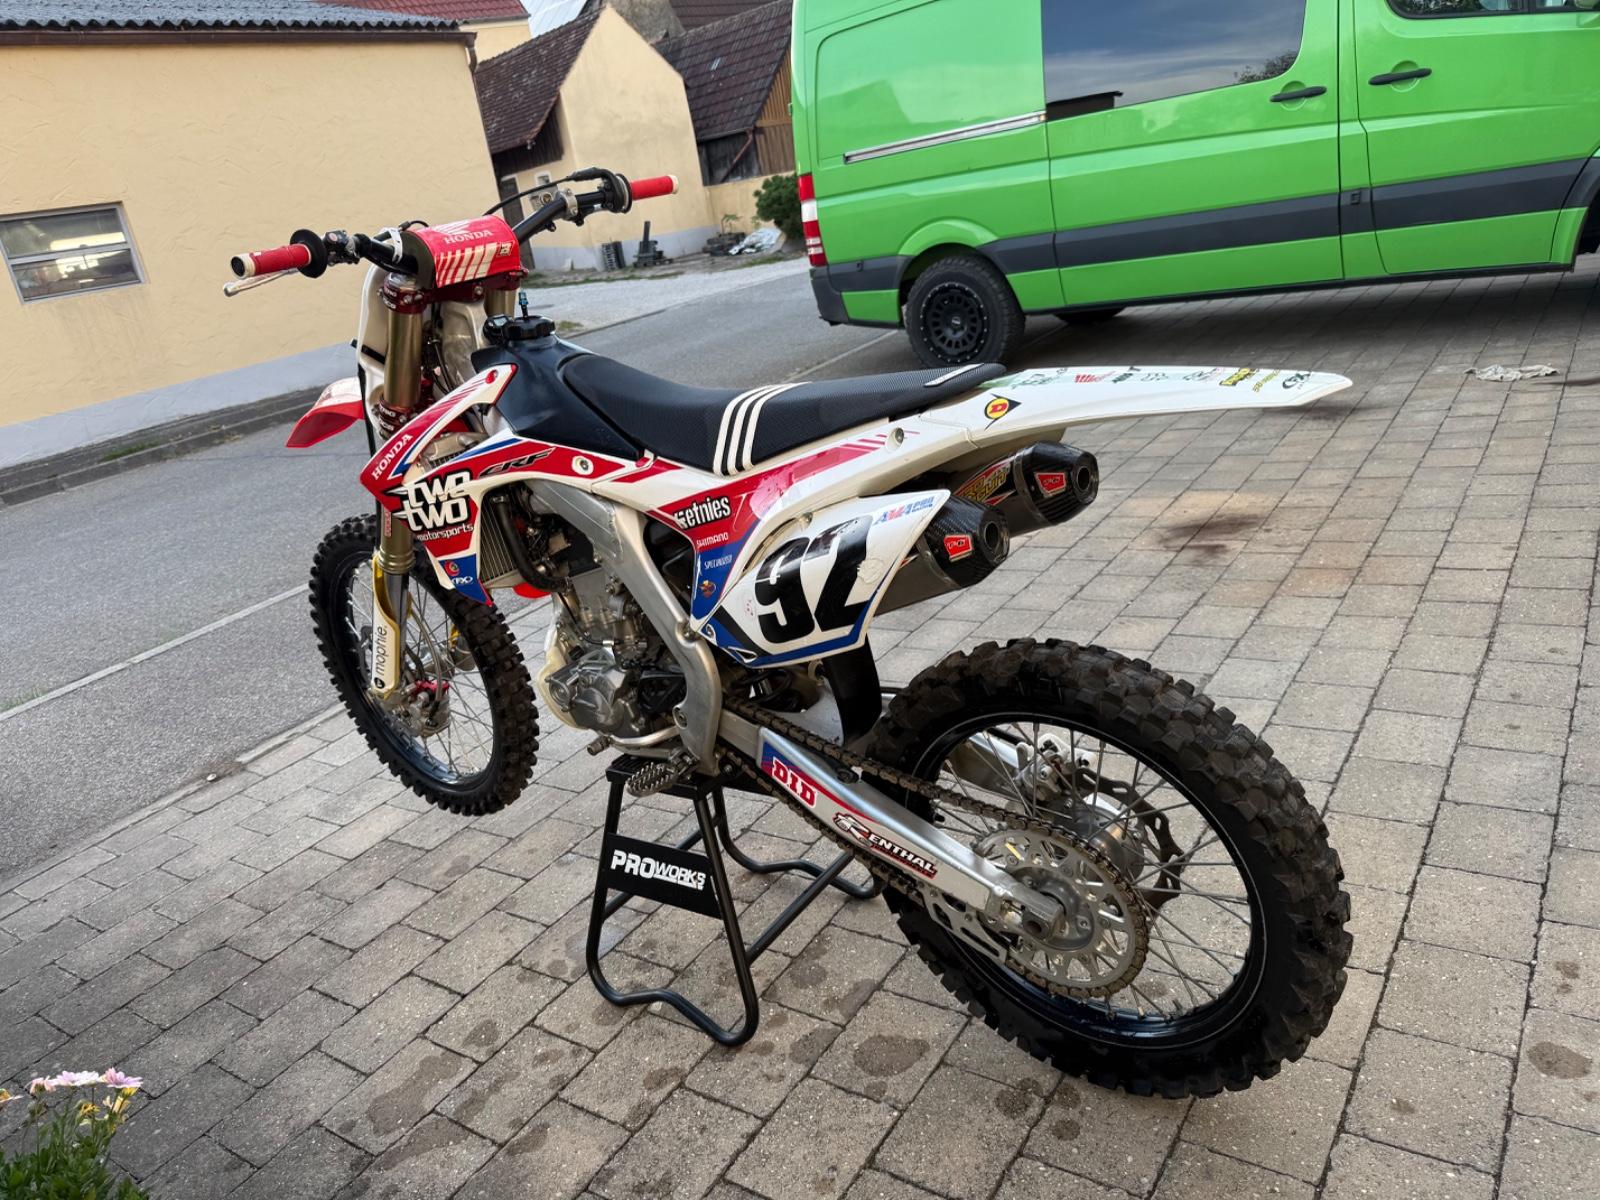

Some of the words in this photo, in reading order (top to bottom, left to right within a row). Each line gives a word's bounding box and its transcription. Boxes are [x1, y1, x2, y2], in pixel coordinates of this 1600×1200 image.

[444, 230, 493, 244] HONDA
[371, 434, 414, 480] HONDA
[479, 448, 556, 478] CRF
[684, 496, 731, 527] etnies
[754, 514, 873, 644] 92
[374, 626, 389, 676] mophie
